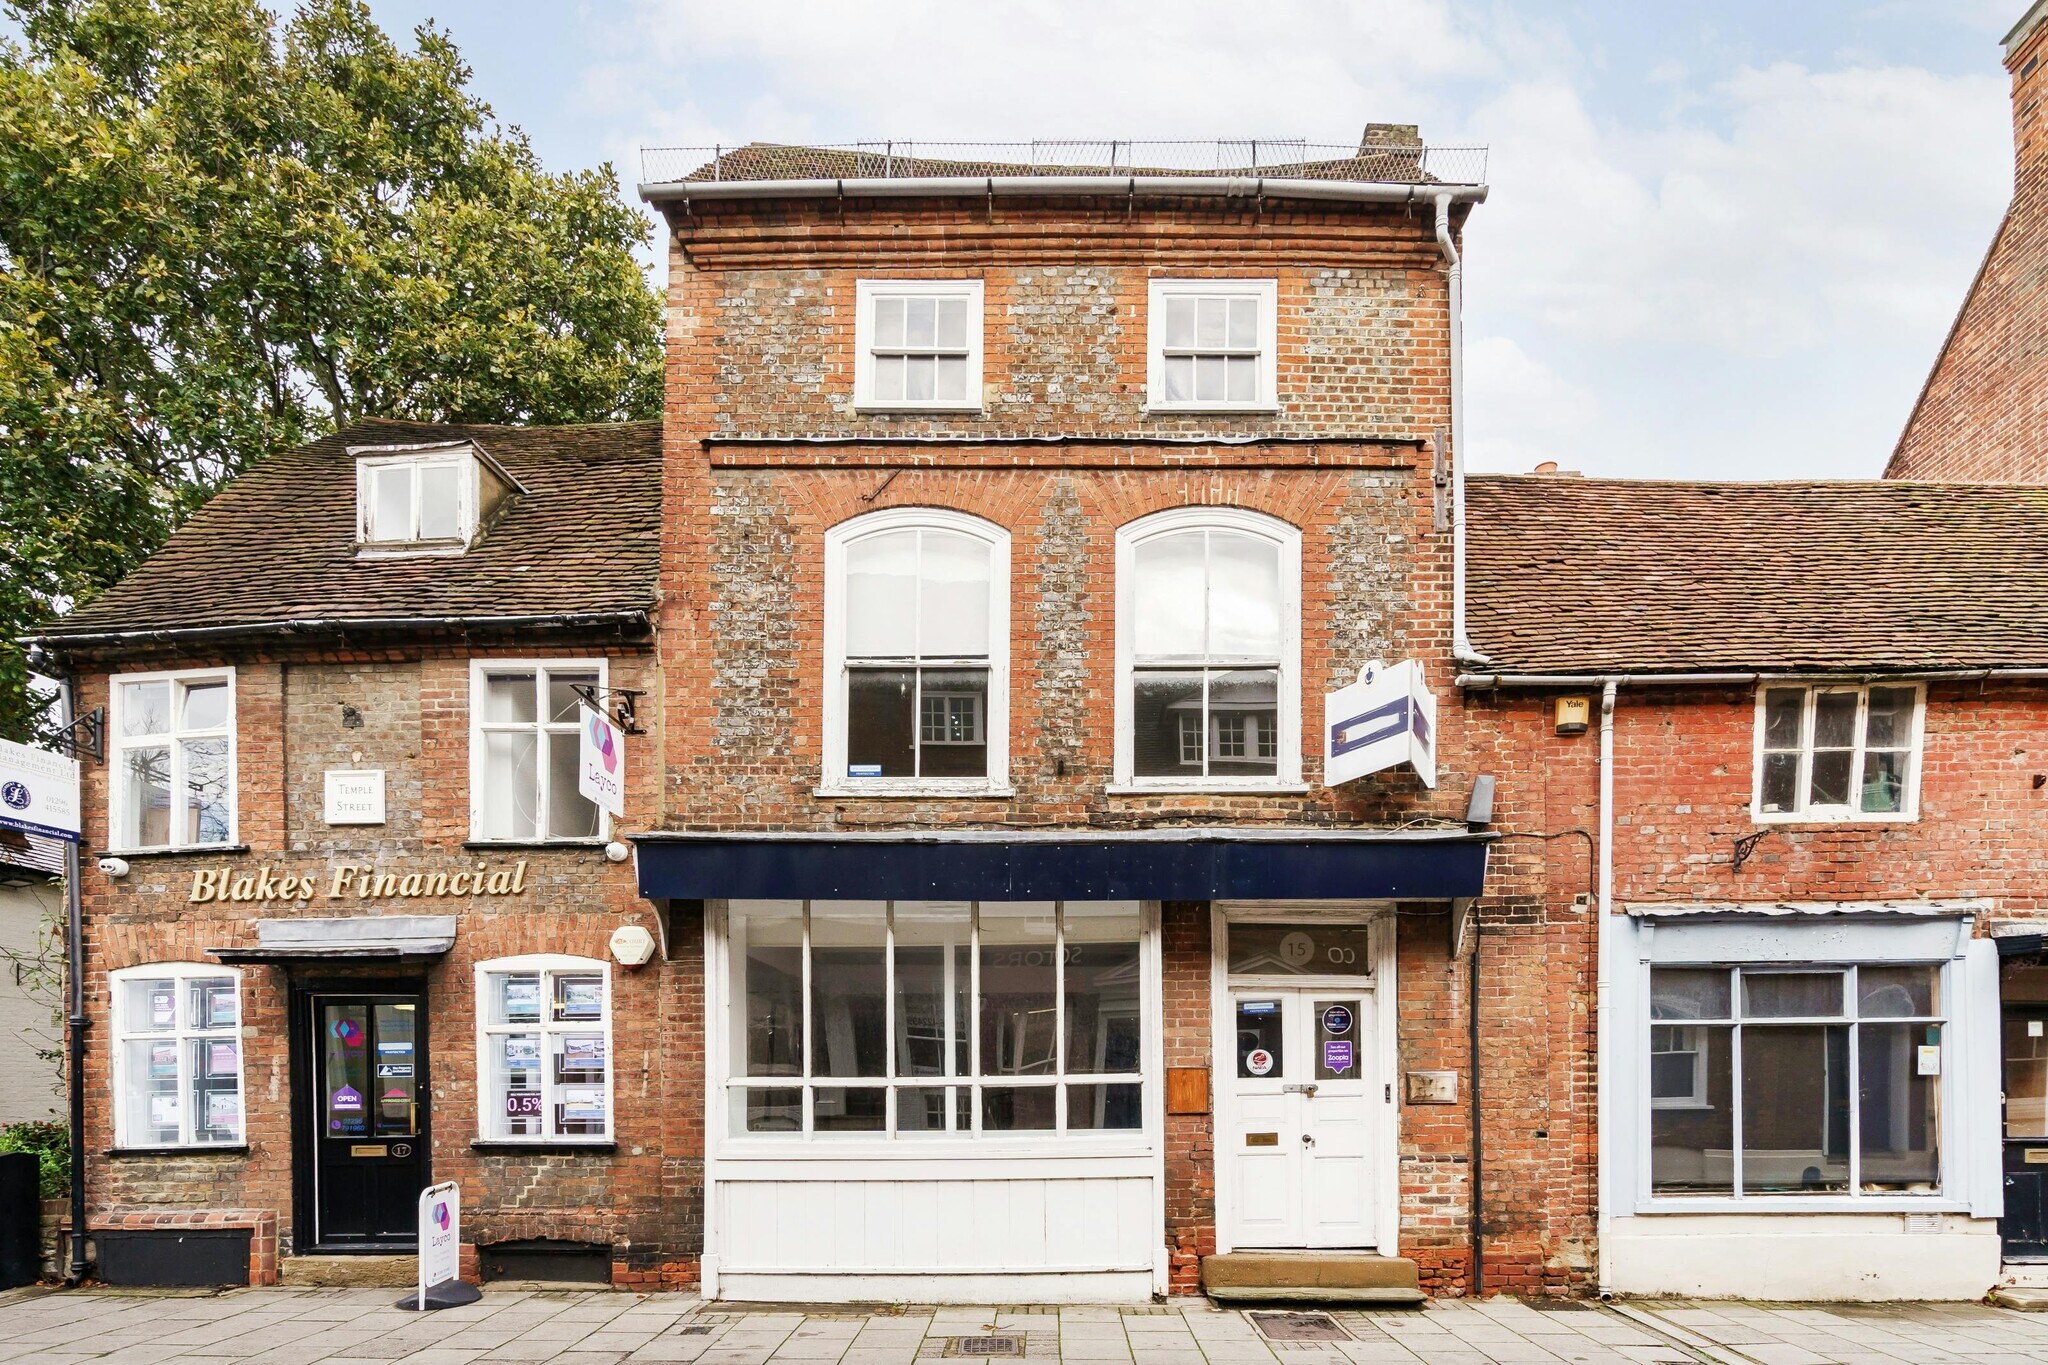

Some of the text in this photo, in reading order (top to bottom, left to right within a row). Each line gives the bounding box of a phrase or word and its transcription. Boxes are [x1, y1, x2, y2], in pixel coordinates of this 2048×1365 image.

[1566, 700, 1584, 708] Yale
[0, 753, 56, 774] anagement
[60, 769, 75, 779] Ltd
[31, 753, 75, 772] Financial
[589, 762, 617, 795] Layco
[337, 784, 373, 794] TEMPLE
[337, 801, 373, 811] STREET
[189, 861, 527, 902] Blakes Financial
[1288, 942, 1305, 957] 15
[1328, 1054, 1349, 1062] Zoopla
[508, 1097, 541, 1111] 0.5%
[396, 1146, 407, 1155] 17
[432, 1233, 451, 1247] Layco
